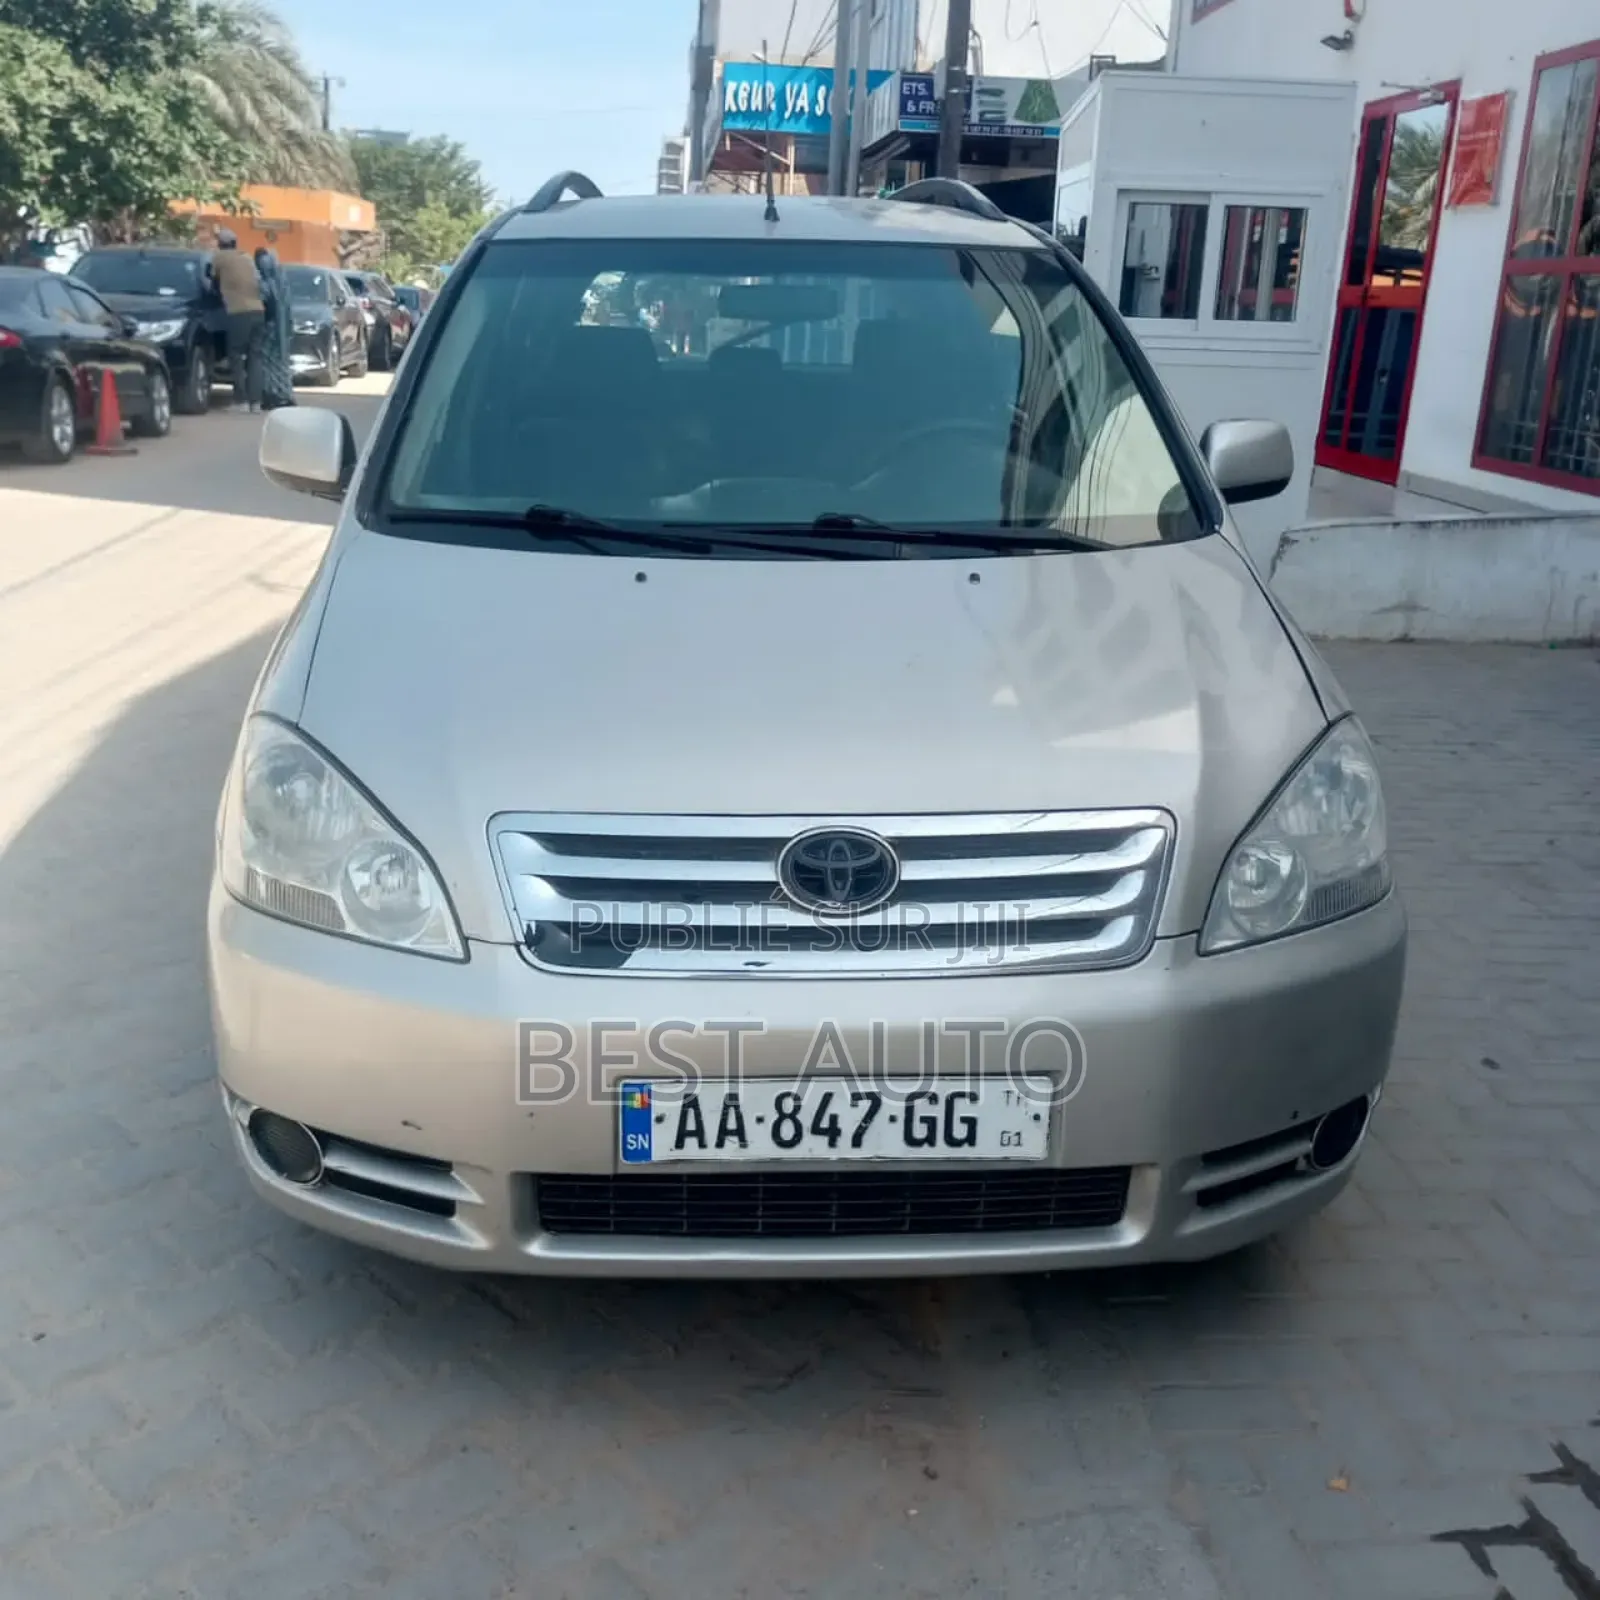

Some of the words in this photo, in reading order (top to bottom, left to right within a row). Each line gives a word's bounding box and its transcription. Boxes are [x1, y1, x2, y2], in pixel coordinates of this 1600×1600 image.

[784, 81, 809, 119] YA
[907, 100, 916, 112] &
[626, 1133, 649, 1150] SN
